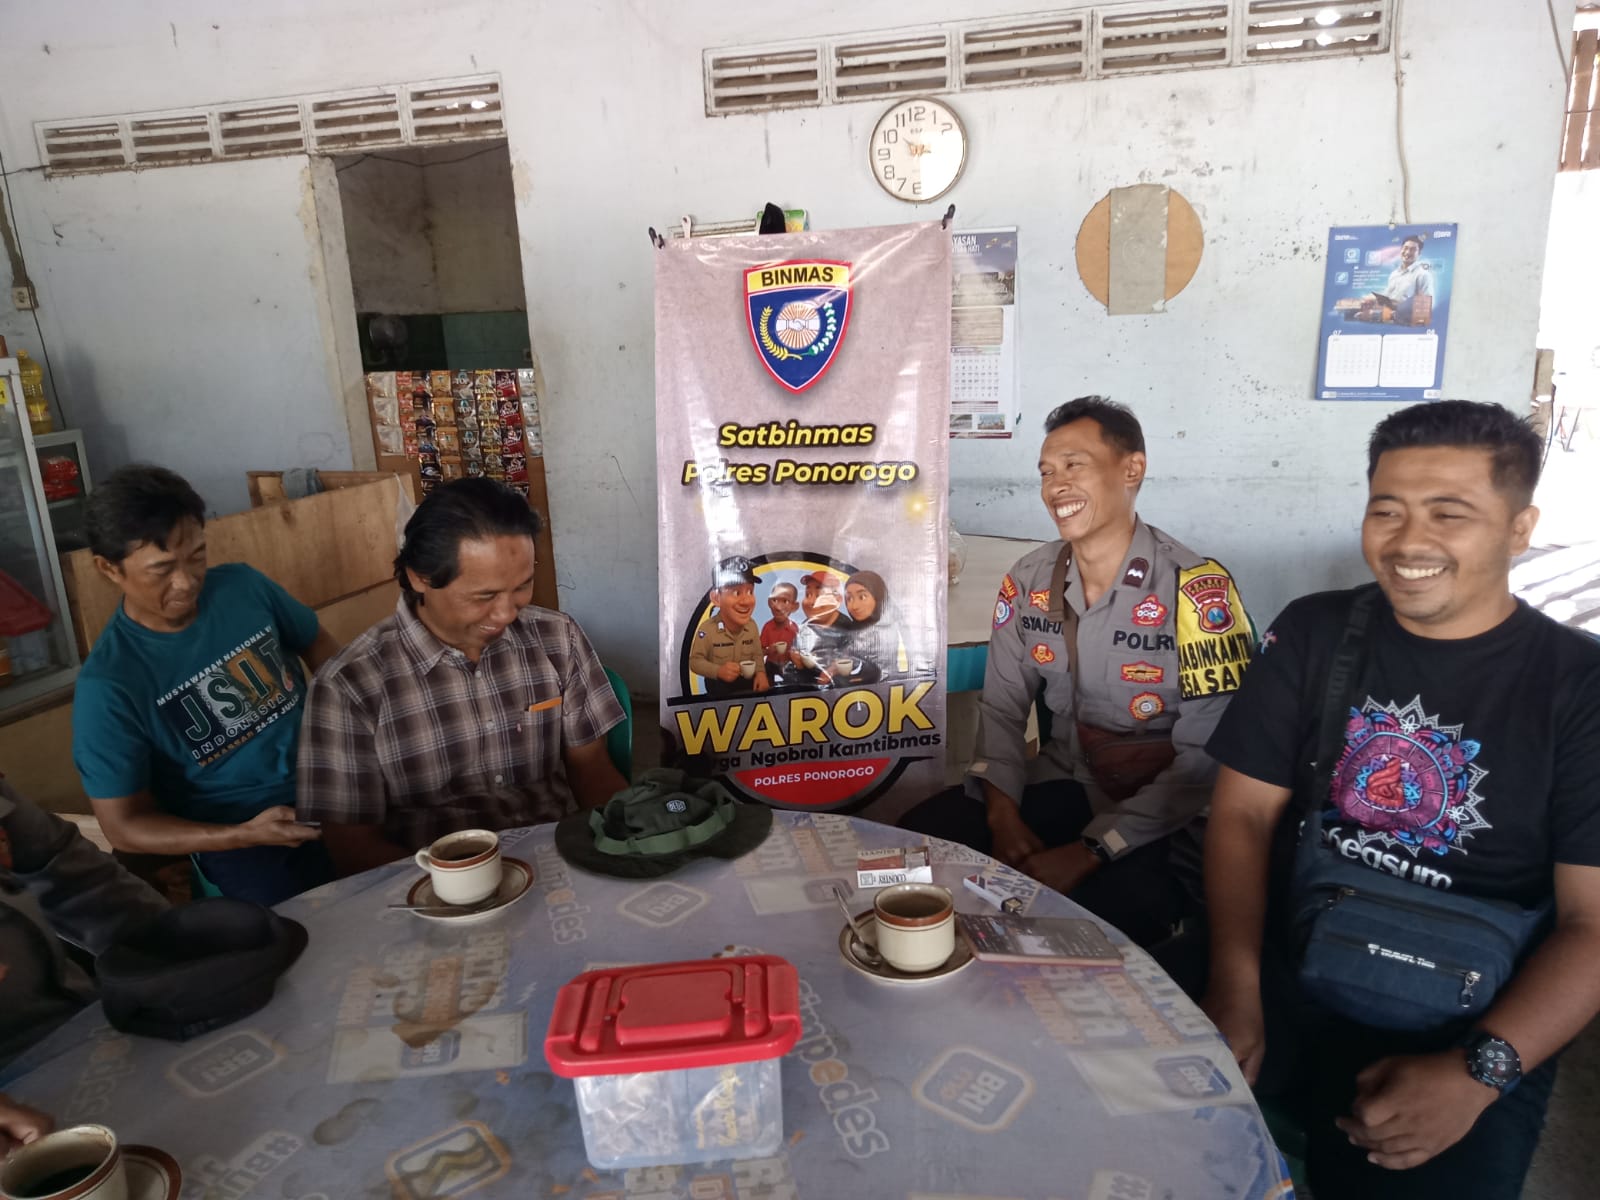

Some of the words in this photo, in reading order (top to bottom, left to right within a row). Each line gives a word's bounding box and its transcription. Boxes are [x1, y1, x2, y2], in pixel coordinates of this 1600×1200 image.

[895, 113, 905, 128] 11
[908, 106, 926, 122] 12
[883, 129, 898, 144] 10
[877, 148, 891, 160] 9
[883, 164, 895, 180] 8
[896, 177, 907, 192] 7
[761, 265, 834, 287] BINMAS
[719, 421, 874, 446] Satbinmas
[683, 461, 767, 485] Polres
[775, 461, 917, 486] Ponorogo
[1113, 630, 1175, 651] POLRI
[156, 659, 223, 707] MUSYAWARAH
[223, 631, 266, 662] NASIONAL
[181, 638, 294, 742] JSIT
[192, 692, 287, 760] INDONESIA
[675, 681, 936, 756] WAROK
[751, 746, 823, 767] Ngobrol
[829, 732, 941, 758] Kamtibmas
[754, 772, 801, 787] POLRES
[804, 765, 874, 781] PONOROGO
[957, 1071, 1008, 1115] BRI
